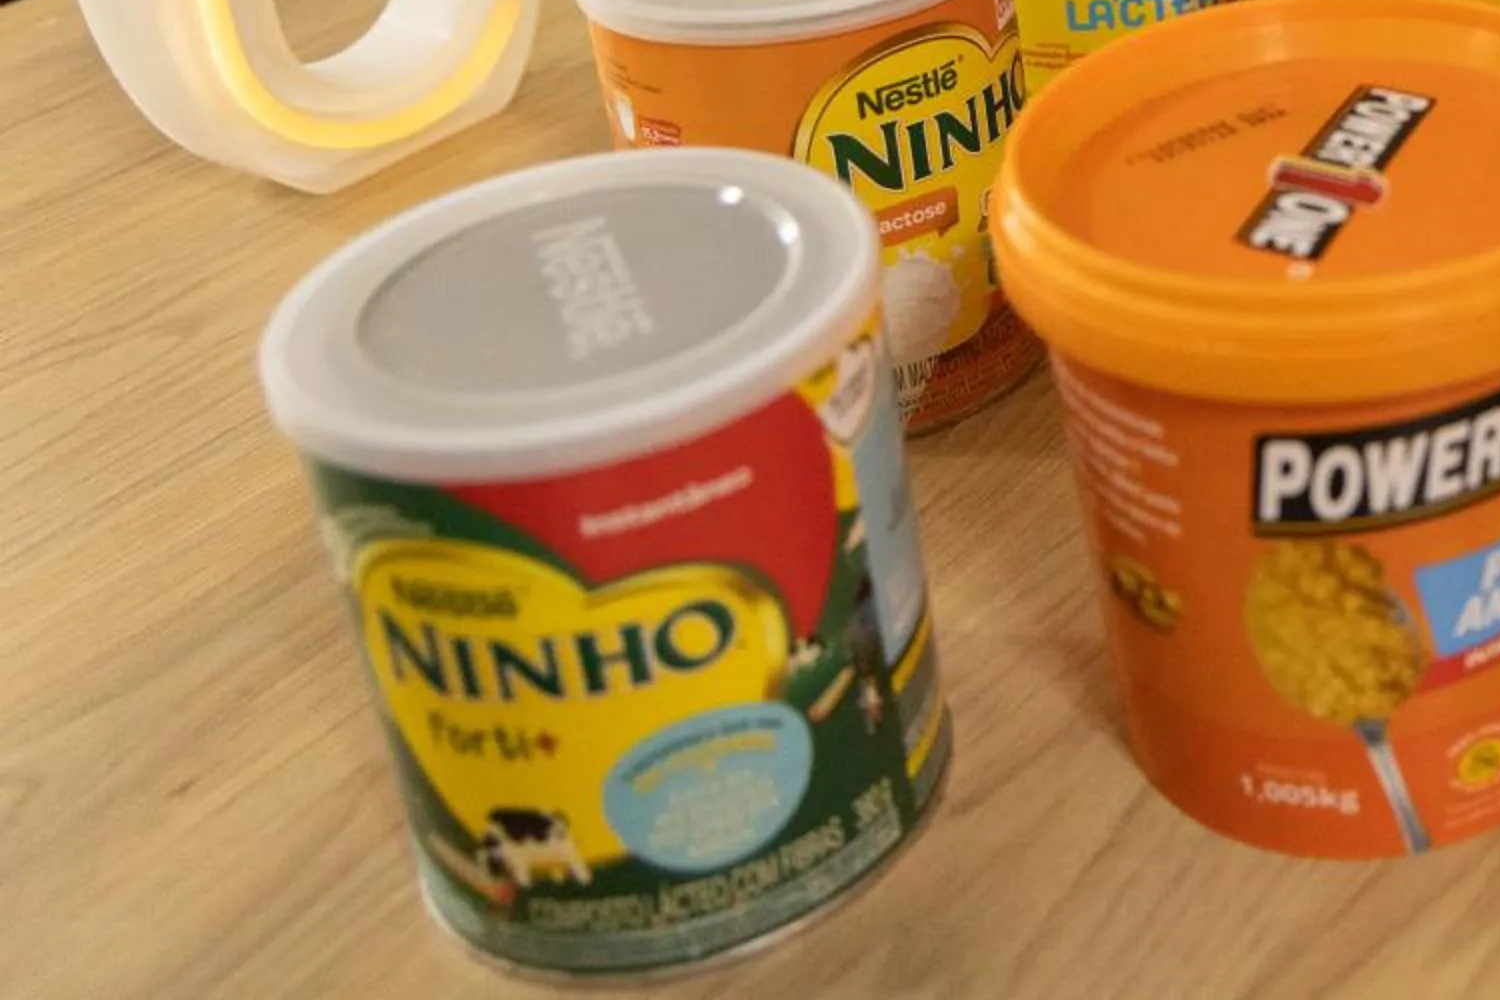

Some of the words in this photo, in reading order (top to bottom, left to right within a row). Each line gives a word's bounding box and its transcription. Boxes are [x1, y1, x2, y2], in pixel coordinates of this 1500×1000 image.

[827, 48, 1026, 192] NINHO
[855, 58, 960, 120] Nestlé
[878, 200, 948, 234] actose
[378, 598, 737, 704] NINHO
